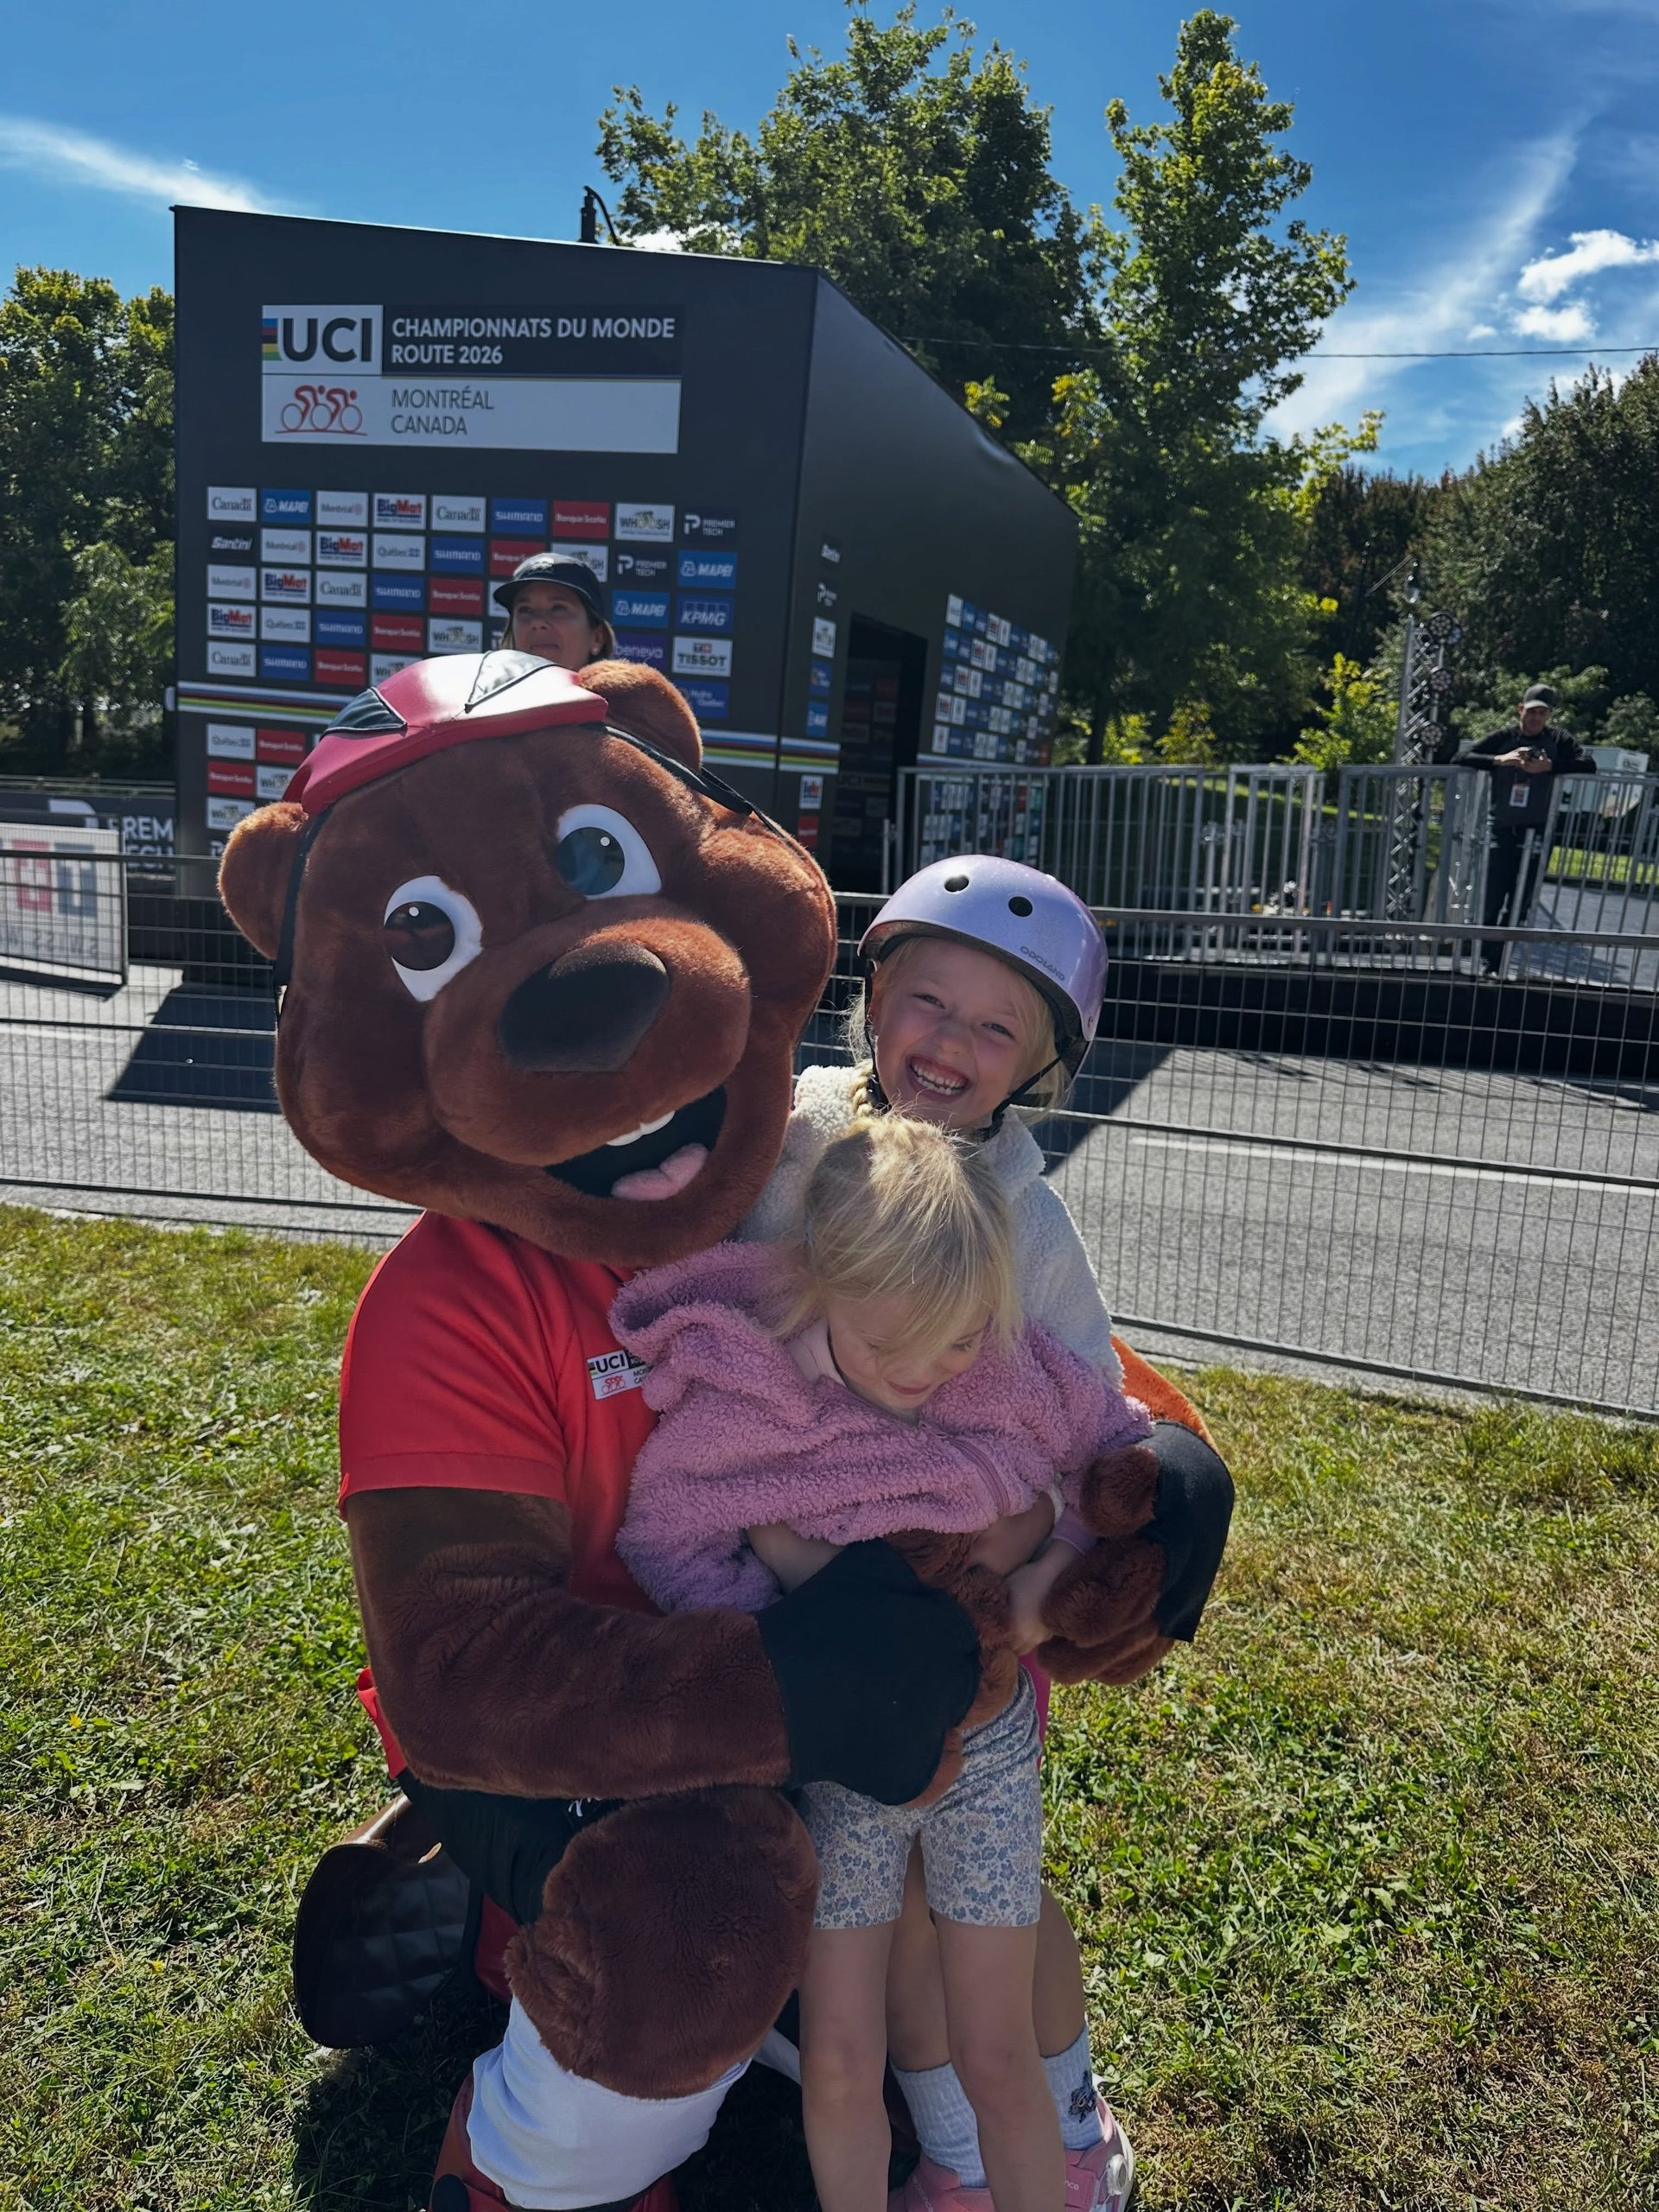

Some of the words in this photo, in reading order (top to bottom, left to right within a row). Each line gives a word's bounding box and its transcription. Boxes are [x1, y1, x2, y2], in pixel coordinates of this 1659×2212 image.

[391, 318, 552, 338] CHAMPIONNATS
[557, 318, 587, 338] DU
[592, 318, 676, 338] MONDE
[283, 317, 372, 362] UCI
[391, 345, 454, 364] ROUTE
[459, 345, 504, 365] 2026
[391, 385, 495, 410] MONTRÉAL
[391, 415, 468, 435] CANADA
[213, 497, 252, 512] Canada
[277, 499, 309, 513] MAPEI
[377, 498, 423, 515] BigMat
[436, 505, 481, 521] Canada
[702, 519, 735, 528] PREMIER
[321, 536, 364, 551] BigMat
[635, 560, 668, 569] PREMIER
[697, 563, 734, 577] MAPEI
[264, 573, 307, 588] BigMat
[320, 582, 363, 596] Canada
[211, 608, 252, 624] BigMat
[630, 603, 667, 617] MAPEI
[681, 611, 728, 626] KPMG
[212, 651, 251, 666] Canada
[677, 653, 727, 667] TISSOT
[1020, 945, 1065, 982] ODOLAND
[595, 1354, 626, 1372] UCI
